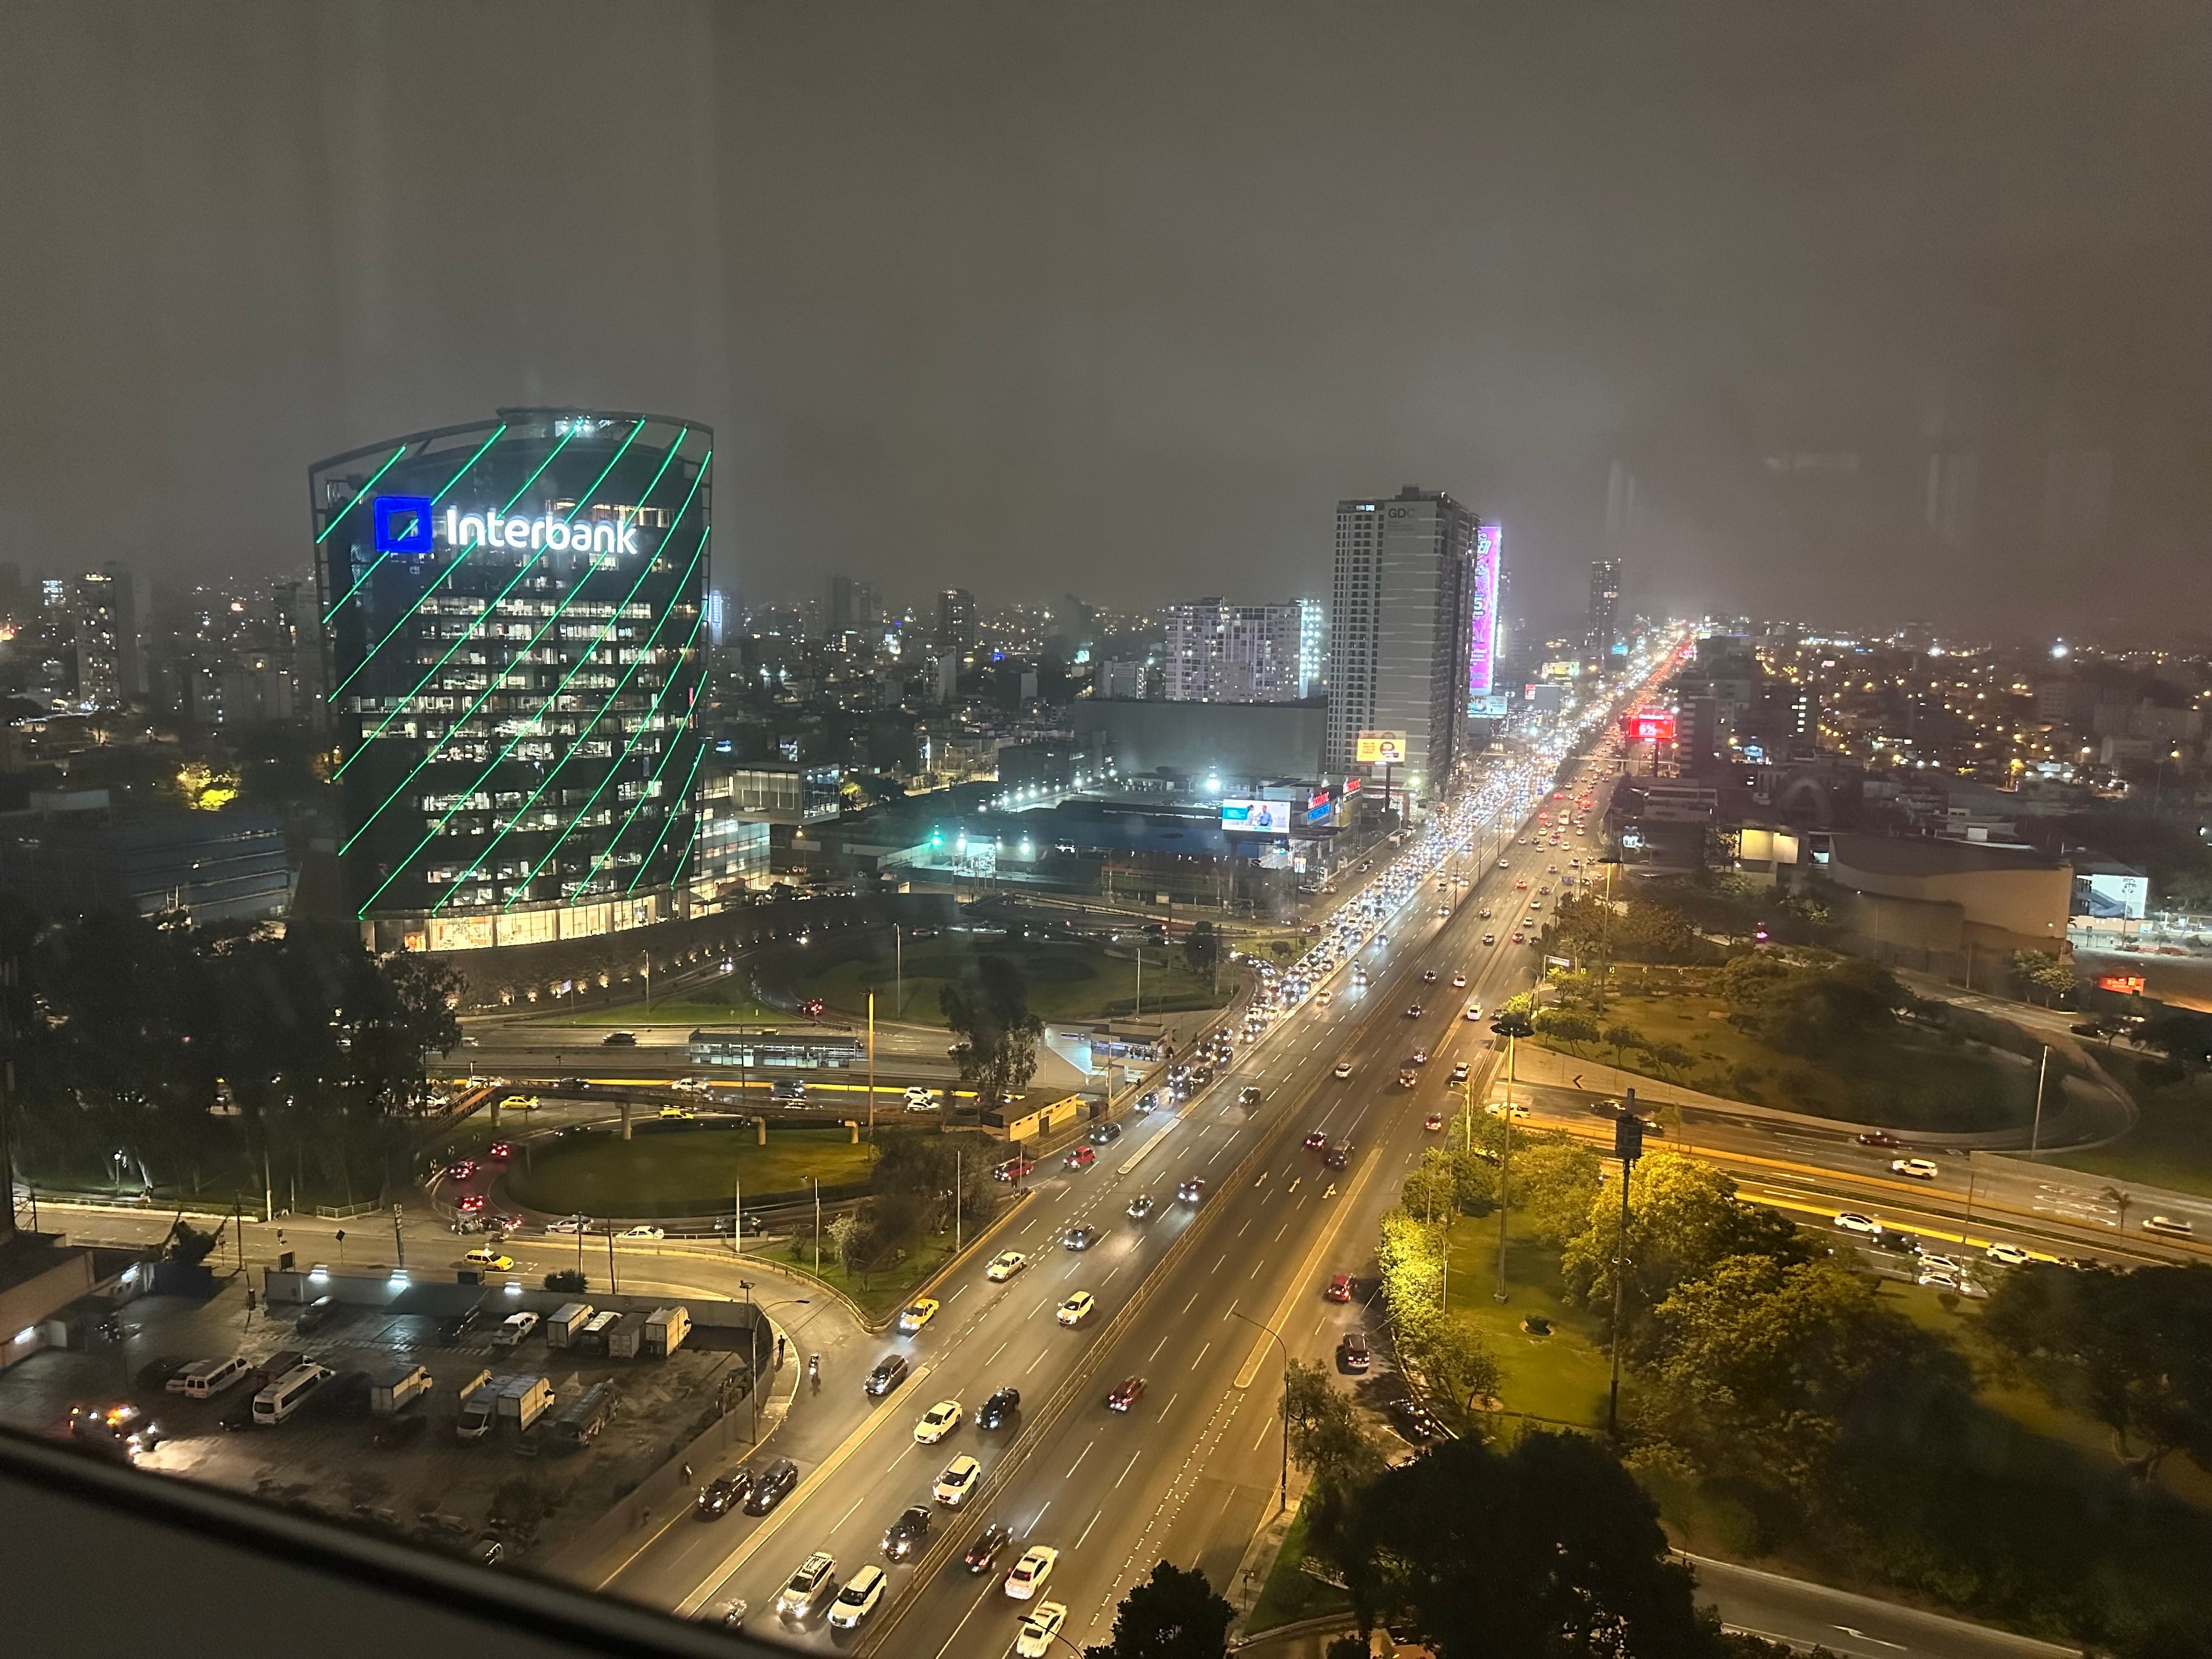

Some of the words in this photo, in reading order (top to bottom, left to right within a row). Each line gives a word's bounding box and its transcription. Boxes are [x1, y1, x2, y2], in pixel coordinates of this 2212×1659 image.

[1389, 508, 1415, 518] GDC
[446, 508, 637, 555] Interbank
[1639, 724, 1656, 733] 6%
